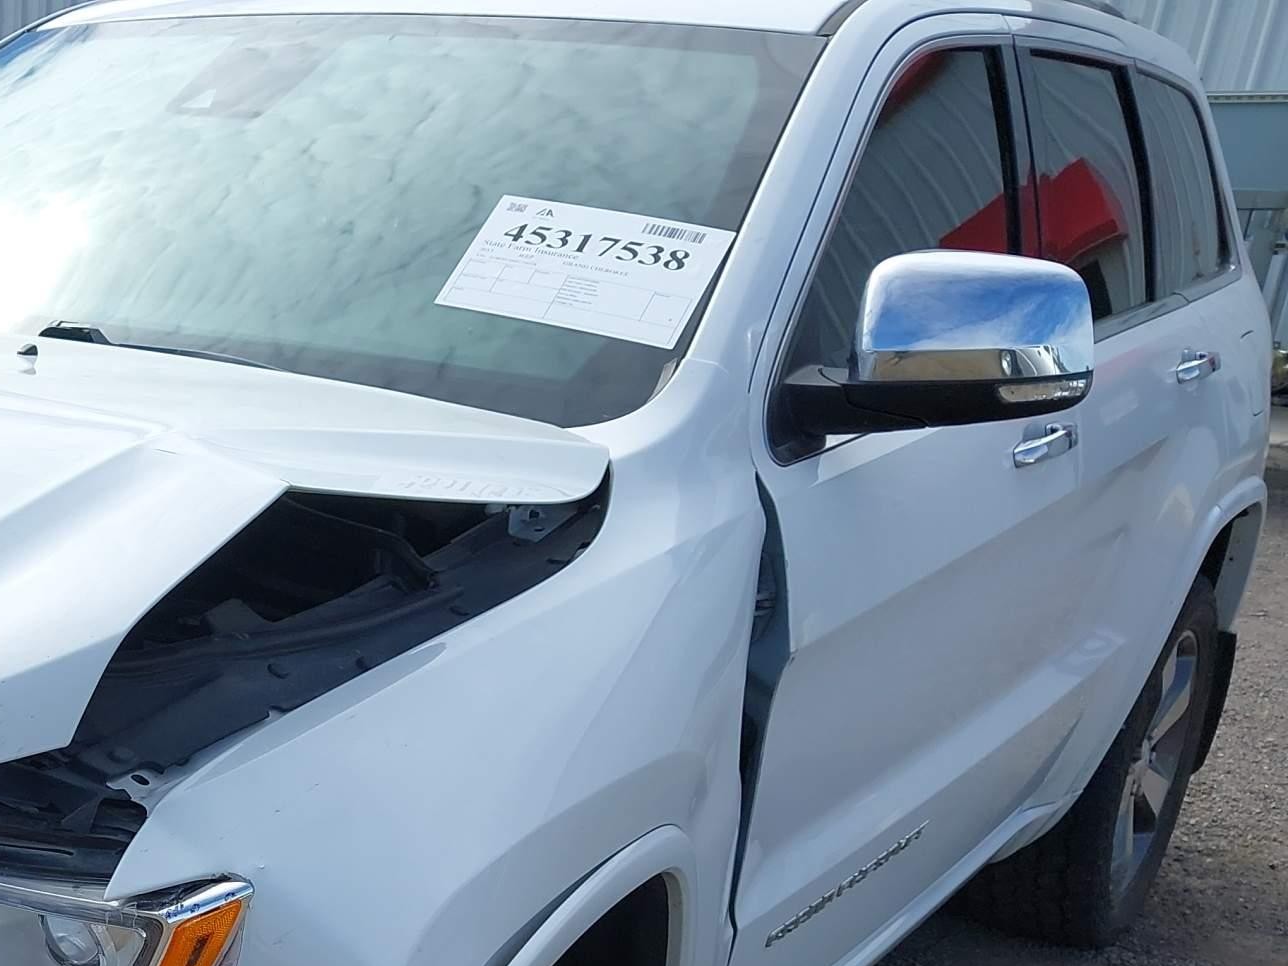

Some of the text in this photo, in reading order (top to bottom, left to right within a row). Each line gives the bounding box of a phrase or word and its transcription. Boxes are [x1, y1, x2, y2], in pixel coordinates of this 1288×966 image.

[504, 224, 690, 271] 45317538
[508, 241, 532, 252] Farm
[534, 247, 580, 260] Insurance
